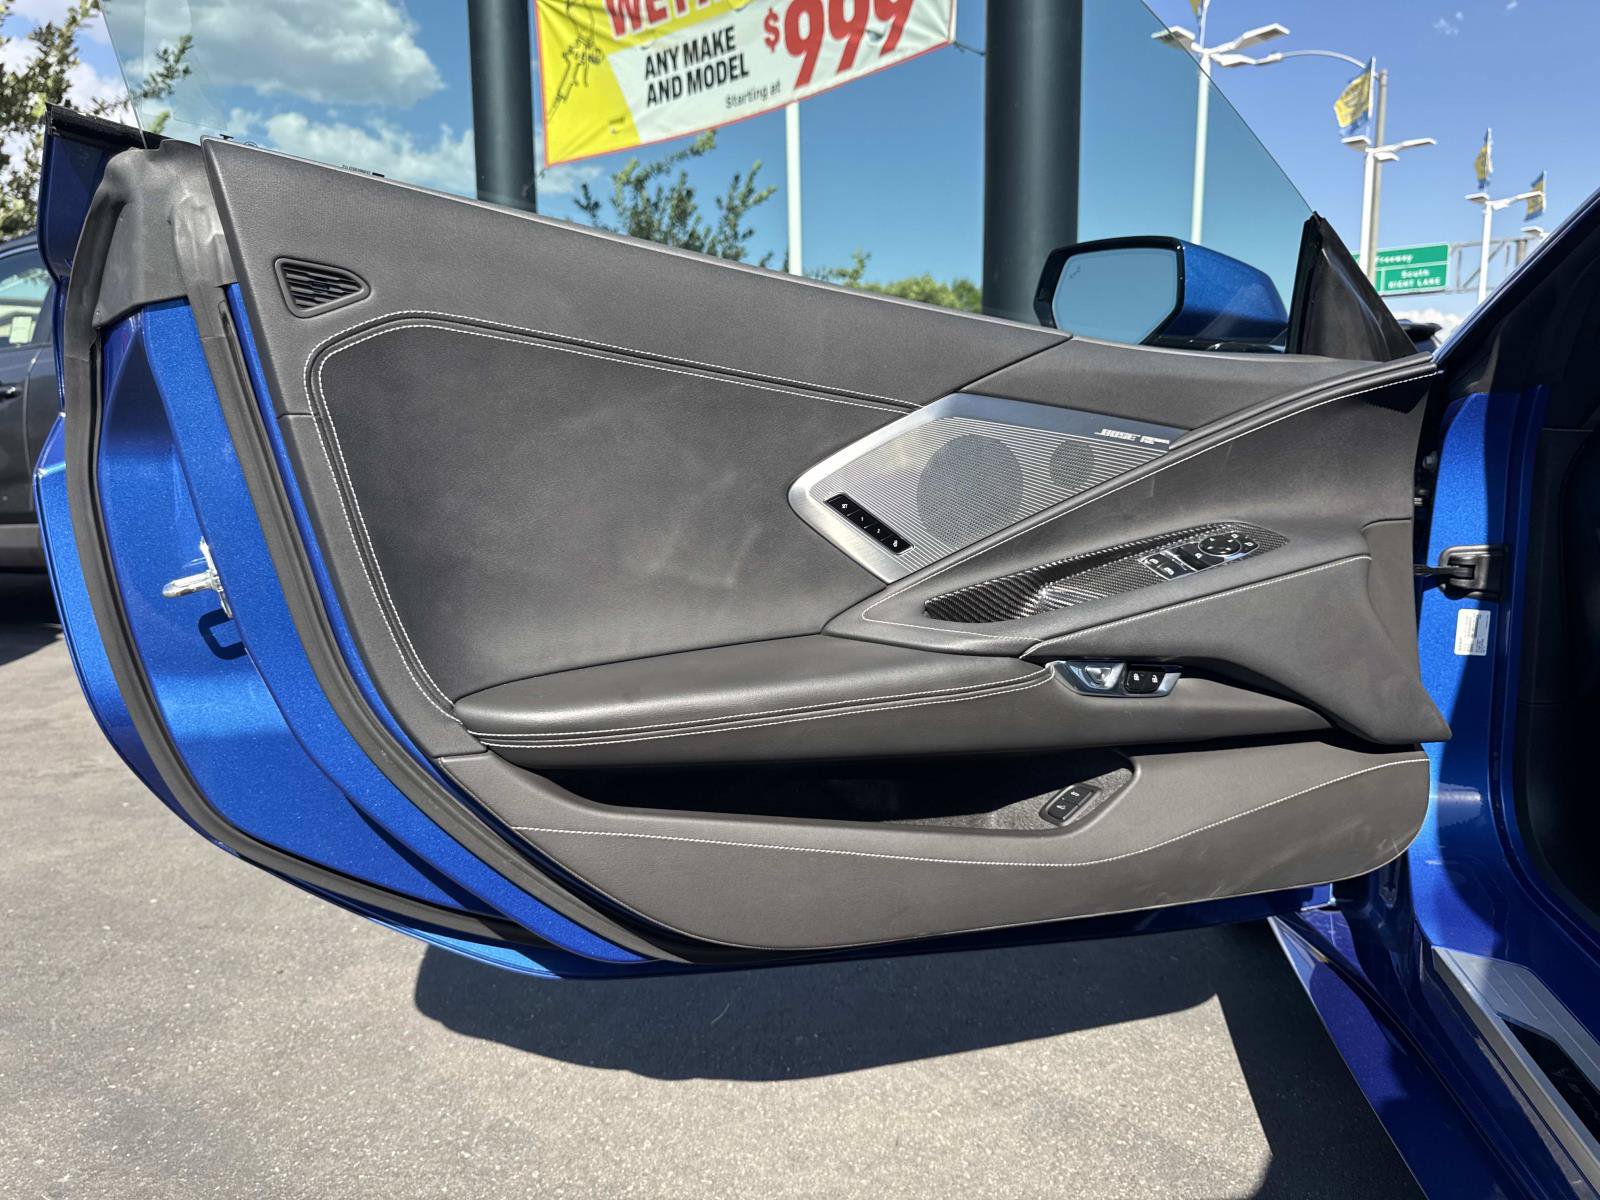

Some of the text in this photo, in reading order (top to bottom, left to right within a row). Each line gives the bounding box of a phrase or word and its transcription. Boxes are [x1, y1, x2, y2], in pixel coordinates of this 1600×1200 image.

[645, 26, 735, 80] ANY MAKE
[647, 53, 749, 108] AND MODEL
[725, 86, 768, 109] Starting
[1401, 269, 1430, 279] South
